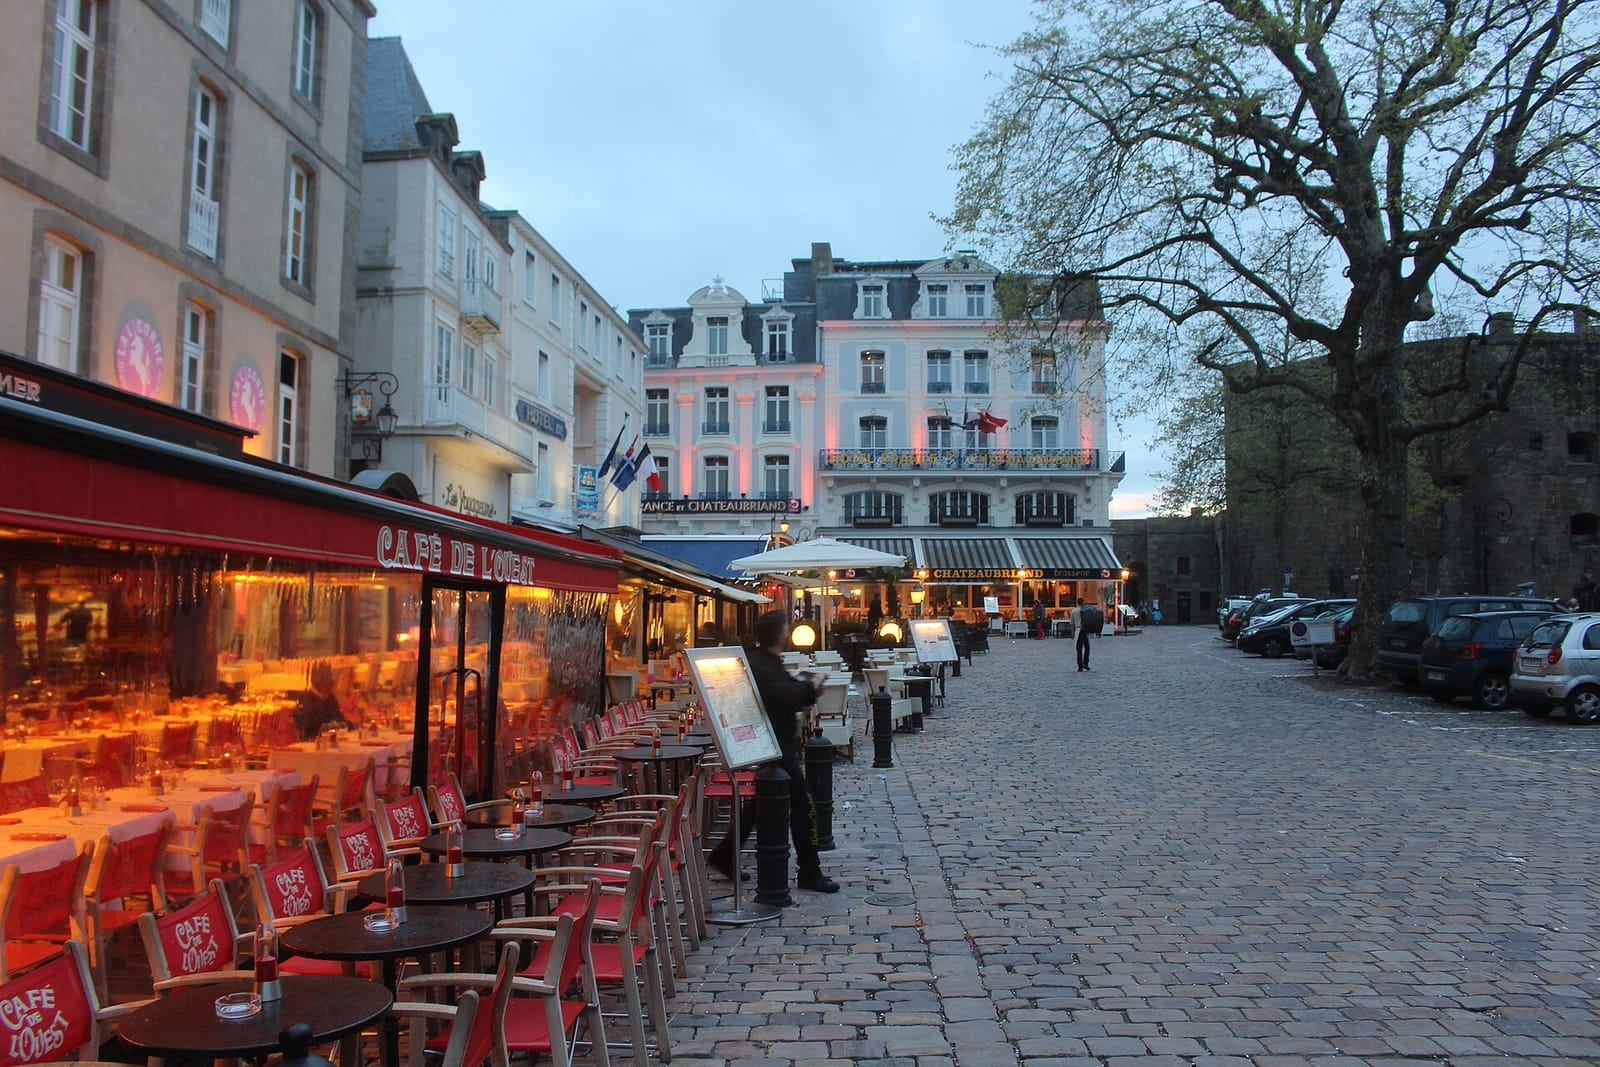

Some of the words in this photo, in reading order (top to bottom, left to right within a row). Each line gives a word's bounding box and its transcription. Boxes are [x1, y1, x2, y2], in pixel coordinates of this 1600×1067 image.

[641, 501, 675, 512] ANCE
[688, 500, 787, 512] CHATEAUBRIAND
[377, 525, 442, 573] CAFÉ
[450, 539, 476, 577] DE
[481, 546, 536, 585] L'OUEST
[276, 866, 305, 896] CAFÉ
[175, 912, 211, 949] CAFÉ
[0, 984, 56, 1031] CAFÉ
